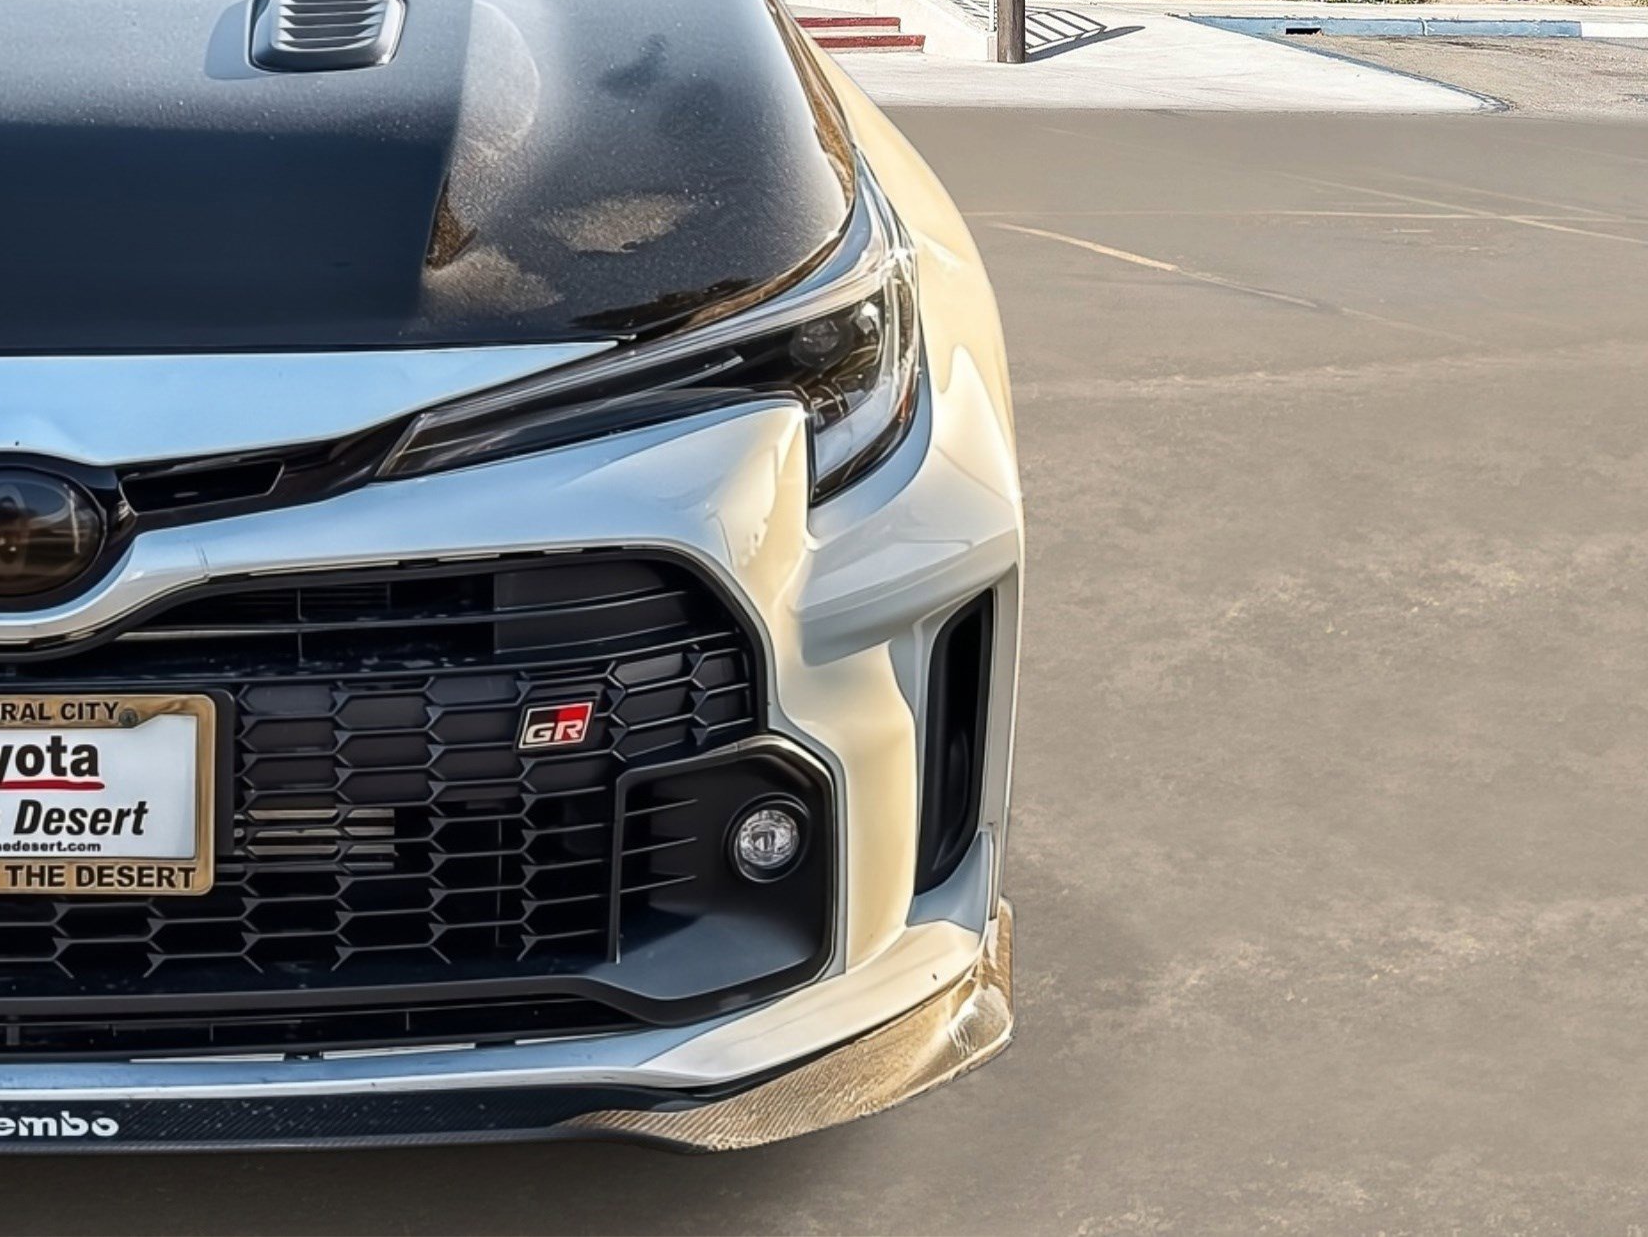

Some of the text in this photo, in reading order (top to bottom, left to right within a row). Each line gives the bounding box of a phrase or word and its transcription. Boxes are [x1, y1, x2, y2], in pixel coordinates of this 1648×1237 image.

[60, 701, 119, 721] CITY
[525, 719, 584, 743] GR
[13, 799, 149, 836] Desert
[4, 864, 67, 888] THE
[74, 864, 196, 890] DESERT
